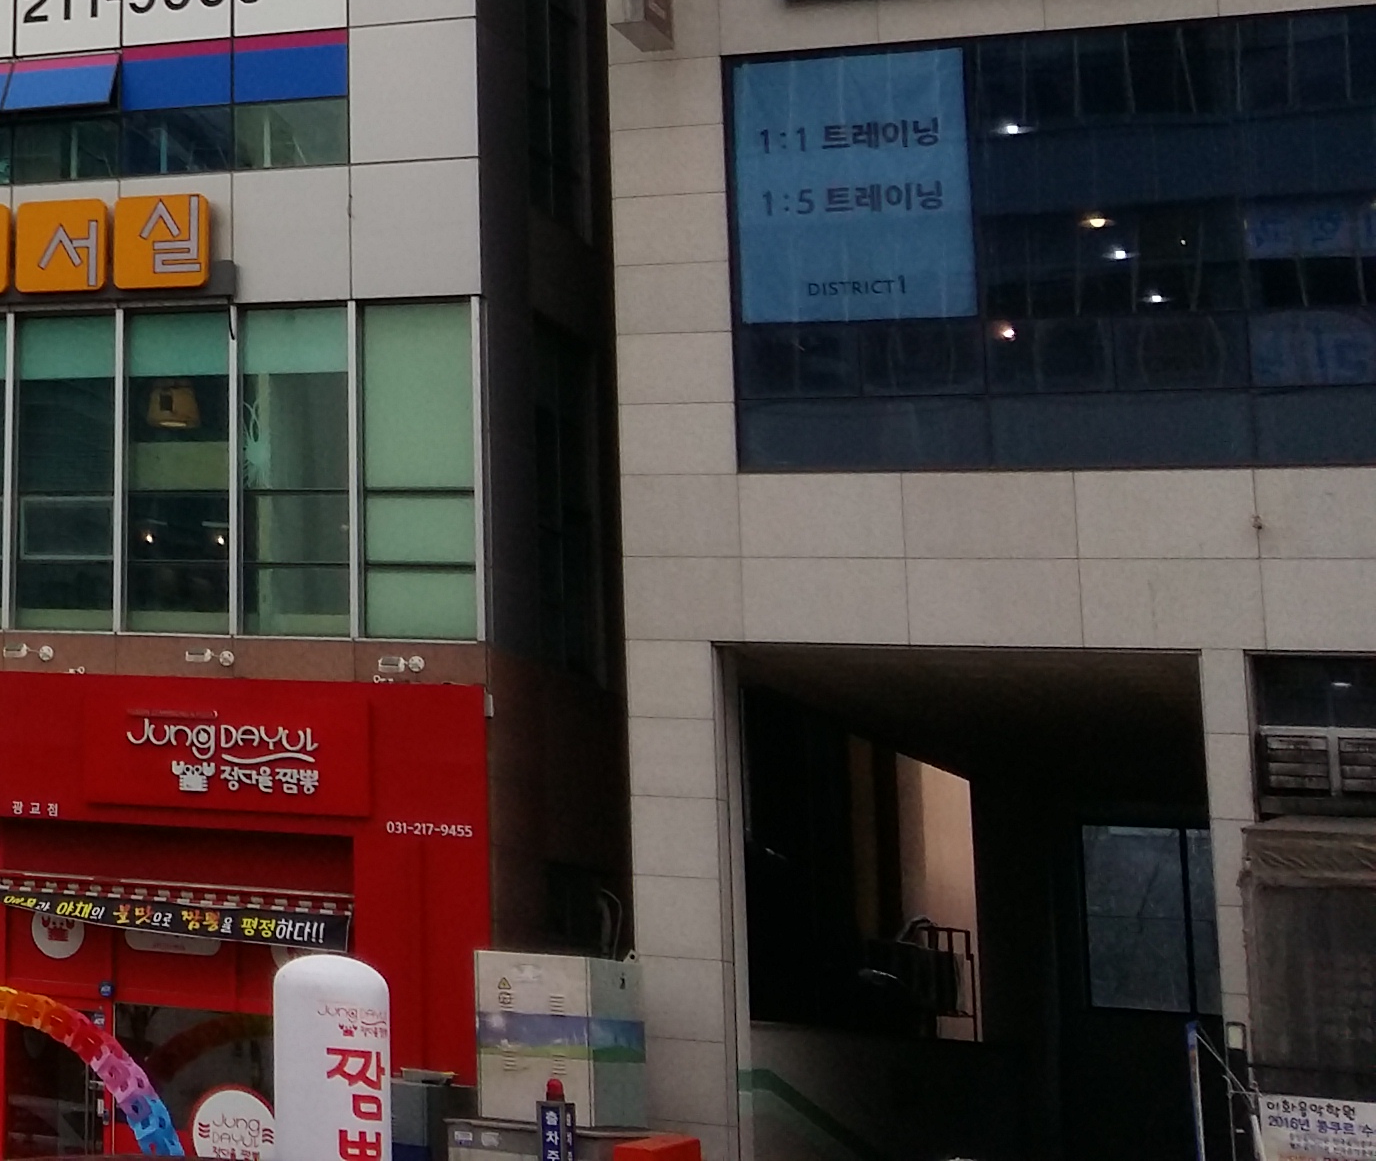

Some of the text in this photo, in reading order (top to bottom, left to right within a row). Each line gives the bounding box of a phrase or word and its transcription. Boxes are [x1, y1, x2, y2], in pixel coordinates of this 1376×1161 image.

[759, 117, 940, 154] 1:1 트레이닝
[762, 180, 944, 216] 1:5 트레이닝
[12, 801, 59, 817] 광교점
[386, 820, 473, 838] 031-217-9455
[1268, 1115, 1311, 1132] 2016년
